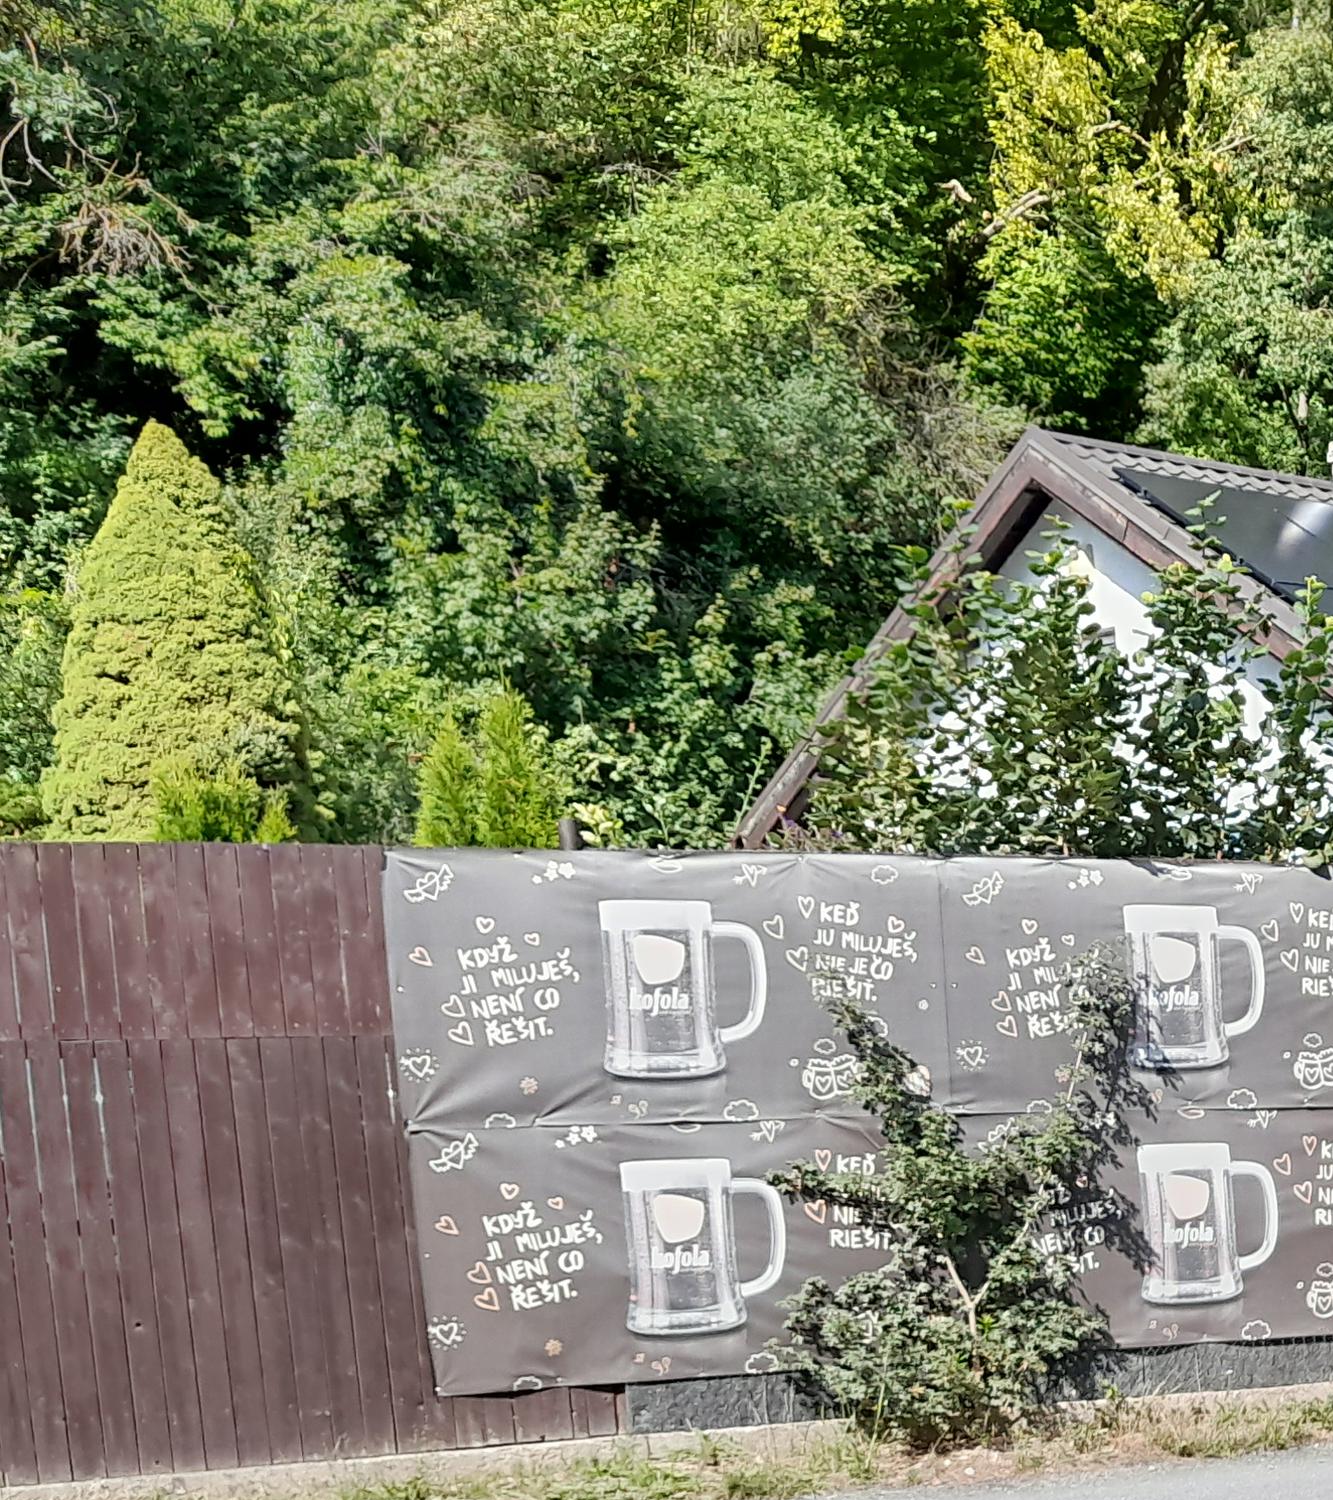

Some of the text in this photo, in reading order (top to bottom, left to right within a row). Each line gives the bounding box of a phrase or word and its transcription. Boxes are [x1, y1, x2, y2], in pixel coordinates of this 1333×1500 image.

[457, 936, 518, 970] KDYŽ
[1005, 937, 1057, 969] KDYŽ
[460, 947, 580, 995] JI MILUJEŠ,
[1007, 973, 1022, 991] JI
[470, 986, 560, 1018] NENÍ CO
[630, 987, 689, 1017] kofola
[1016, 984, 1062, 1014] NENÍ
[485, 1016, 554, 1047] ŘEŠIT.
[482, 1201, 543, 1237] KDYŽ
[486, 1210, 604, 1261] JI MILUJEŠ,
[495, 1250, 584, 1285] NENÍ CO
[650, 1244, 710, 1275] kofola
[510, 1279, 578, 1311] ŘEŠIT.
